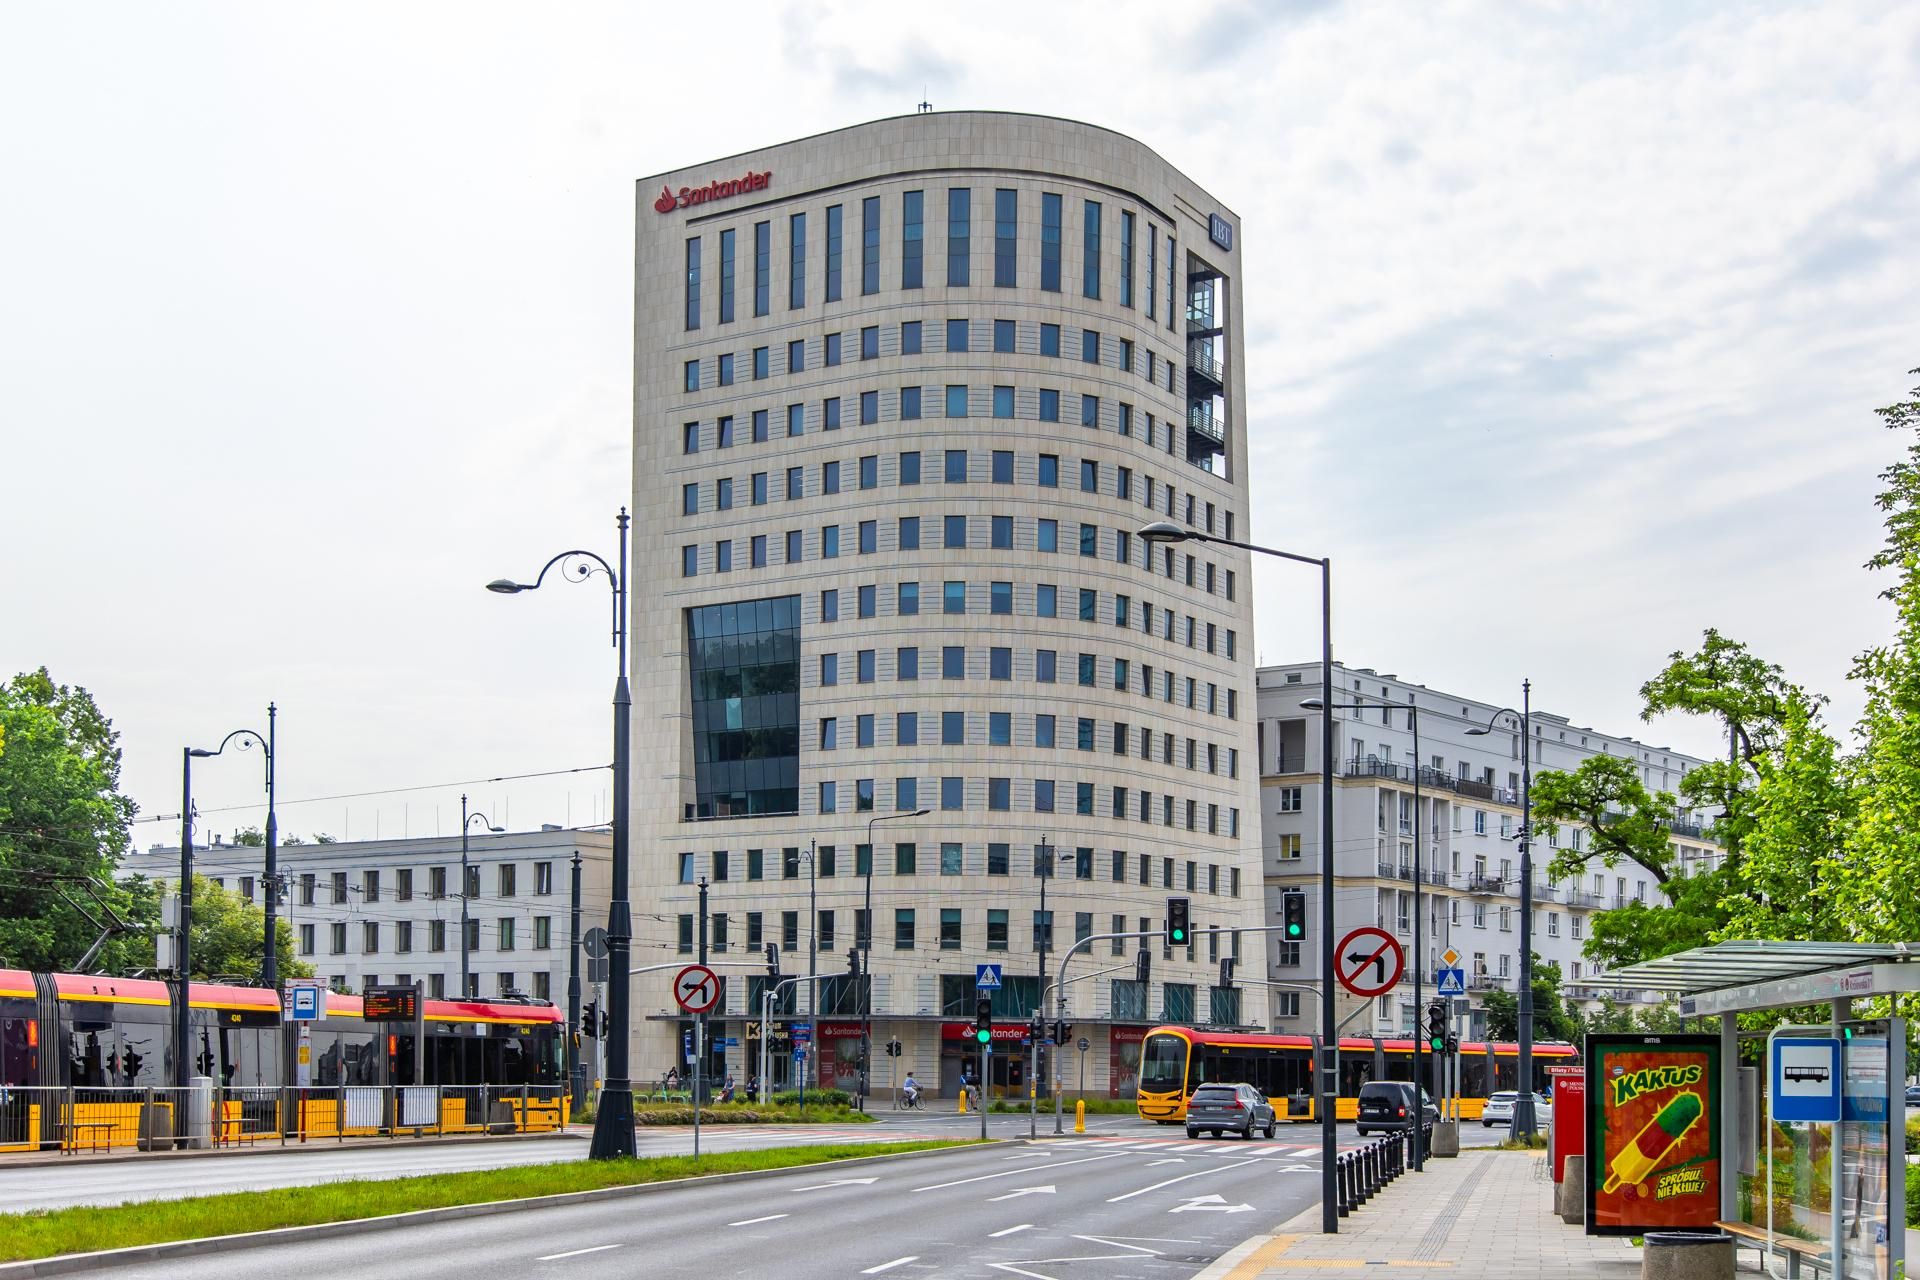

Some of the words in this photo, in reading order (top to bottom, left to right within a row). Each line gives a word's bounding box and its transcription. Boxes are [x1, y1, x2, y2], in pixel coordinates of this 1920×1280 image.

[678, 171, 772, 208] Santander
[1213, 219, 1231, 245] IBT
[1610, 1065, 1703, 1107] KAKTUS
